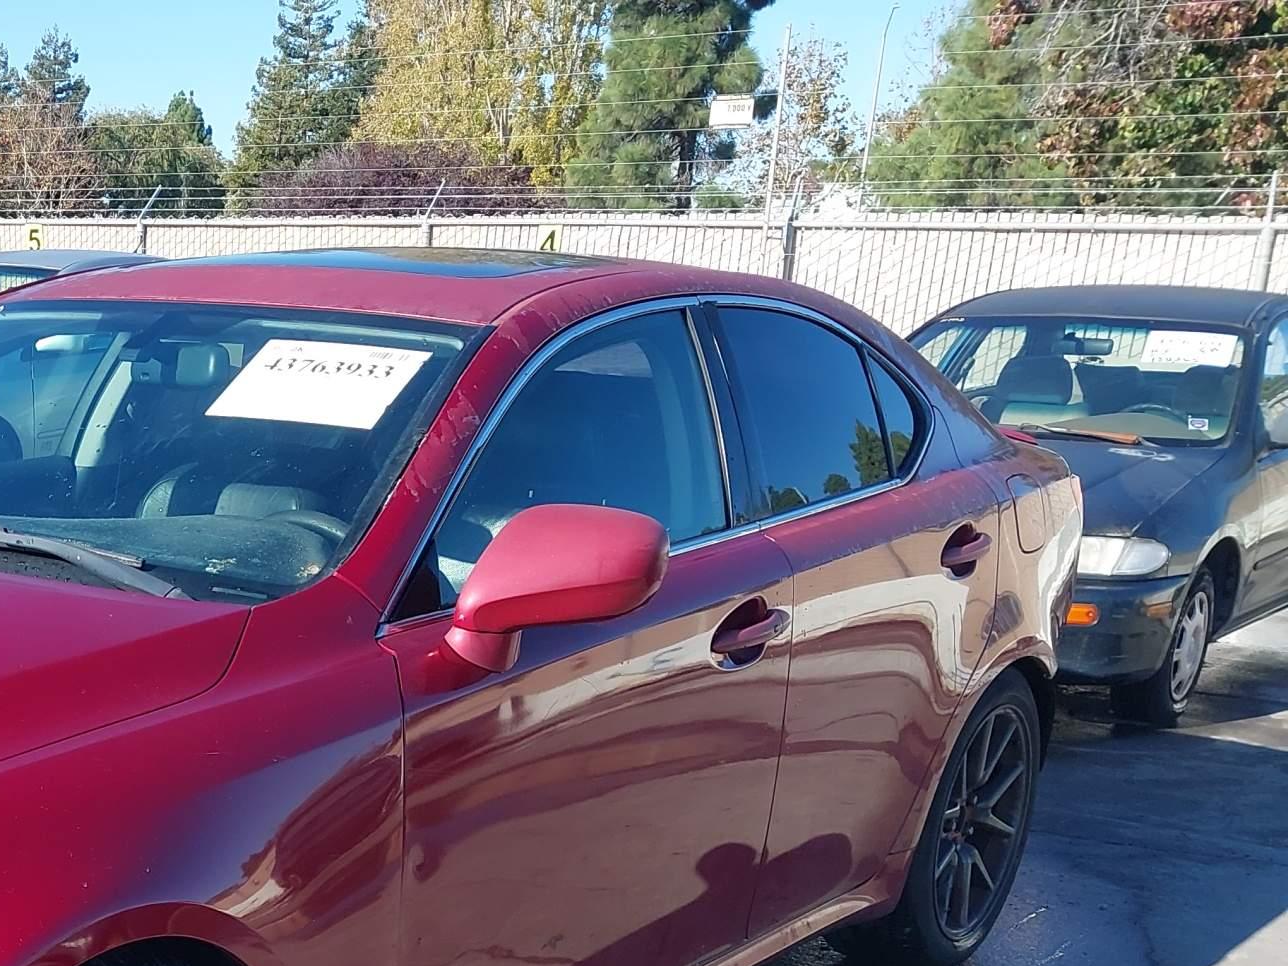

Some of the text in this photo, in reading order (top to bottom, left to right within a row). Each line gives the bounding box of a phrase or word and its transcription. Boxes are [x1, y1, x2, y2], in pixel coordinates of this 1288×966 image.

[28, 228, 41, 251] 5
[539, 229, 557, 252] 4
[264, 357, 395, 379] 43763933
